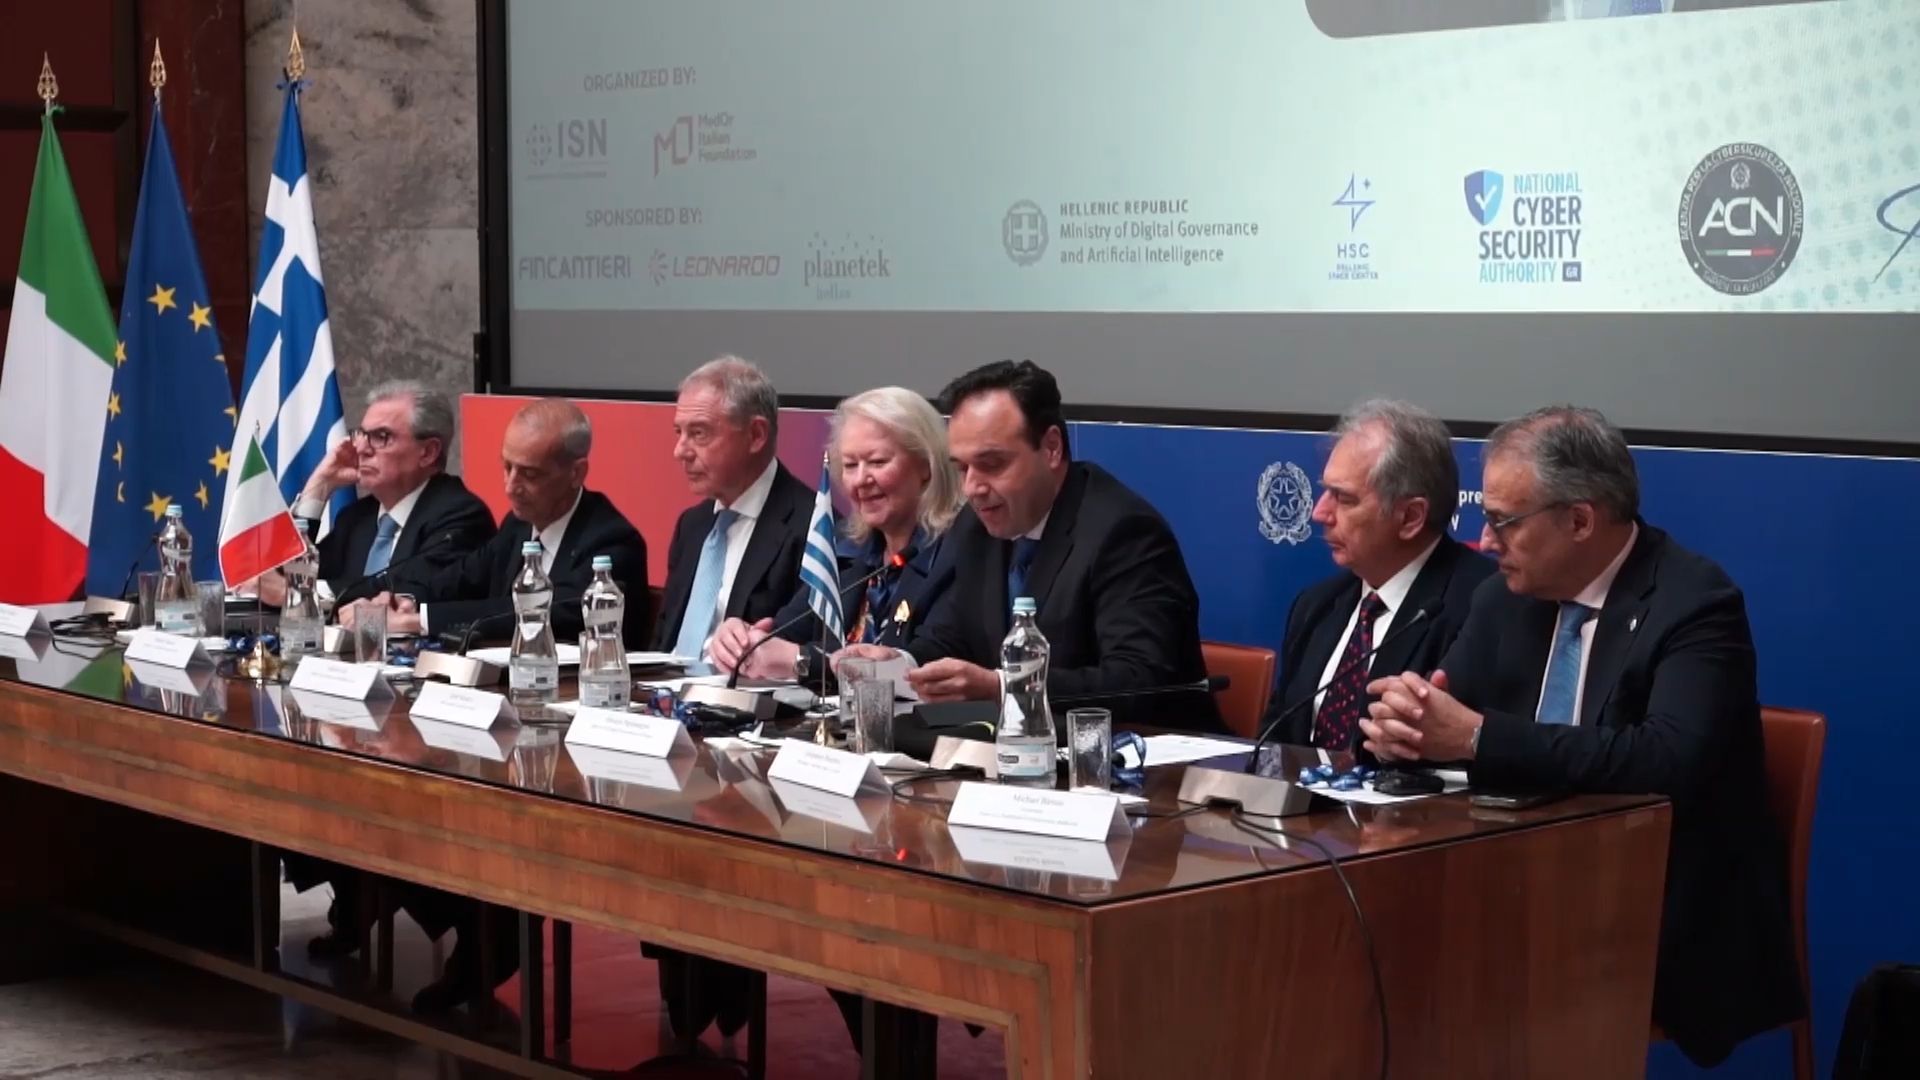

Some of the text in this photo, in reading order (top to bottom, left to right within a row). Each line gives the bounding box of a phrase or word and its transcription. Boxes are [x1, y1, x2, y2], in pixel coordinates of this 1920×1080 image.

[583, 66, 697, 92] ORGANIZED BY:
[558, 119, 607, 158] ISN
[1513, 172, 1582, 194] NATIONAL
[585, 206, 703, 228] SPONSORED BY:
[1060, 199, 1189, 217] HELLENIC REPUBLIC
[1512, 195, 1582, 226] CYBER
[1698, 195, 1784, 237] ACN
[1060, 219, 1259, 241] Ministry of Digital Governance
[1060, 244, 1224, 266] and Artificial Intelligence
[1336, 242, 1370, 259] HSC
[1479, 229, 1581, 260] SECURITY
[518, 254, 632, 280] FINCANTIERI
[672, 255, 781, 278] LEONARDO
[804, 248, 891, 287] planetek
[1479, 261, 1557, 283] AUTHORITY
